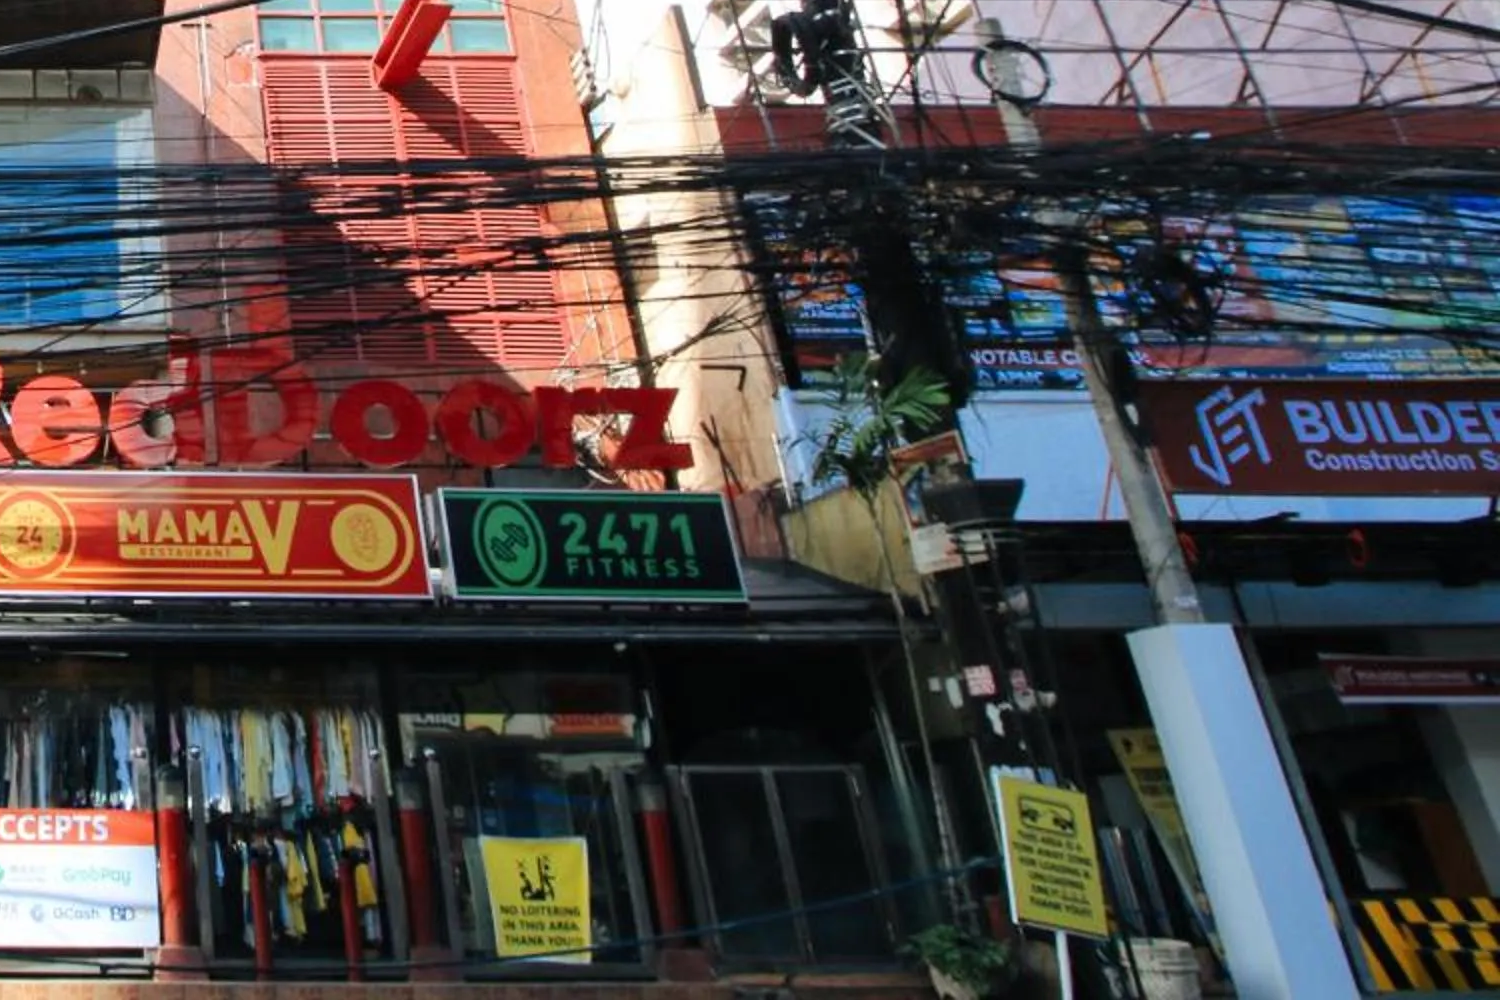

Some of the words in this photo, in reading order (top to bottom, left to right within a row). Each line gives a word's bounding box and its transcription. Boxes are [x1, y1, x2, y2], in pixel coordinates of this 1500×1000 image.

[1305, 449, 1476, 472] Construction
[15, 525, 43, 545] 24
[117, 508, 252, 545] MAMA
[239, 500, 301, 575] V
[558, 512, 696, 556] 2471
[139, 547, 231, 558] RESTAURANT
[565, 558, 701, 578] FITNESS
[499, 905, 518, 916] NO
[519, 920, 546, 931] THIS
[504, 934, 545, 946] THANK
